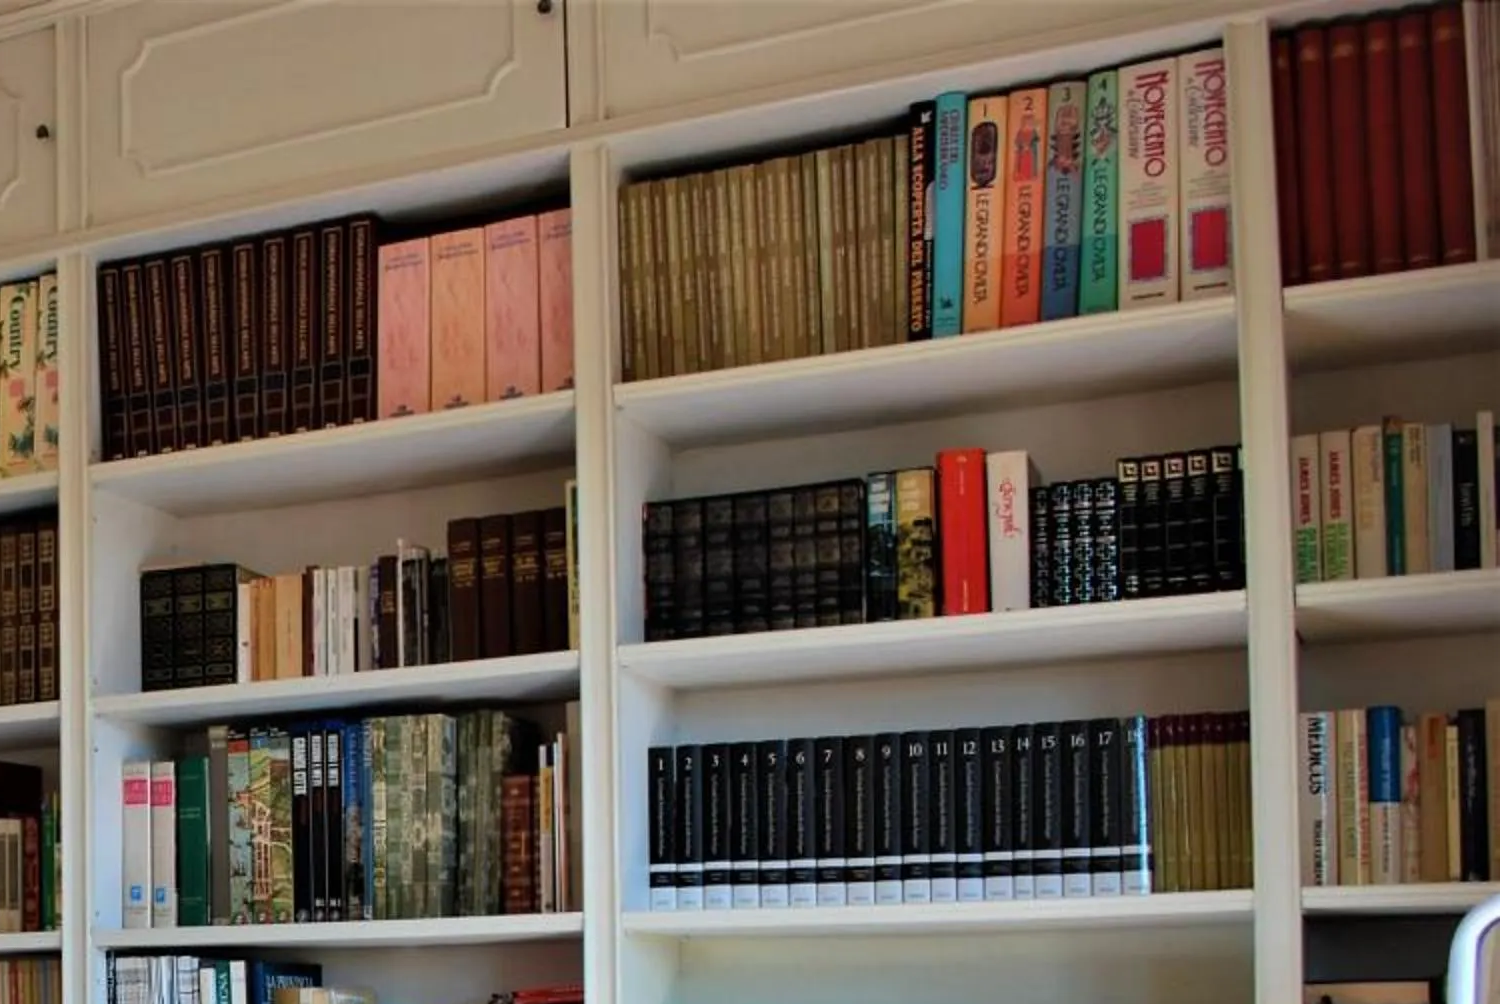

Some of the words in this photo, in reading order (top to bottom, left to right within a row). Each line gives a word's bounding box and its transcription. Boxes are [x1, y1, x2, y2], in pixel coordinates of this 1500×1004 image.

[1098, 79, 1107, 90] 4
[1062, 88, 1071, 102] 3
[1023, 96, 1033, 110] 2
[1136, 71, 1169, 178] NOVECENTO
[1093, 185, 1107, 234] GRANDI
[1018, 202, 1031, 251] GRANDI
[1055, 194, 1070, 245] GRANDI
[976, 209, 989, 257] GRANDI
[9, 295, 25, 372] Country
[1017, 737, 1029, 750] 14
[1041, 735, 1056, 749] 15
[1071, 733, 1085, 747] 16
[1099, 731, 1113, 745] 17
[881, 745, 891, 758] 9
[909, 743, 922, 757] 10
[936, 742, 948, 756] 11
[963, 741, 976, 755] 12
[991, 739, 1005, 753] 13
[711, 755, 718, 767] 3
[740, 754, 748, 766] 4
[767, 752, 777, 765] 5
[795, 751, 805, 764] 6
[823, 749, 832, 762] 7
[854, 748, 865, 761] 8
[1308, 717, 1327, 796] MEDICUS
[657, 757, 664, 771] 1
[684, 757, 692, 770] 2
